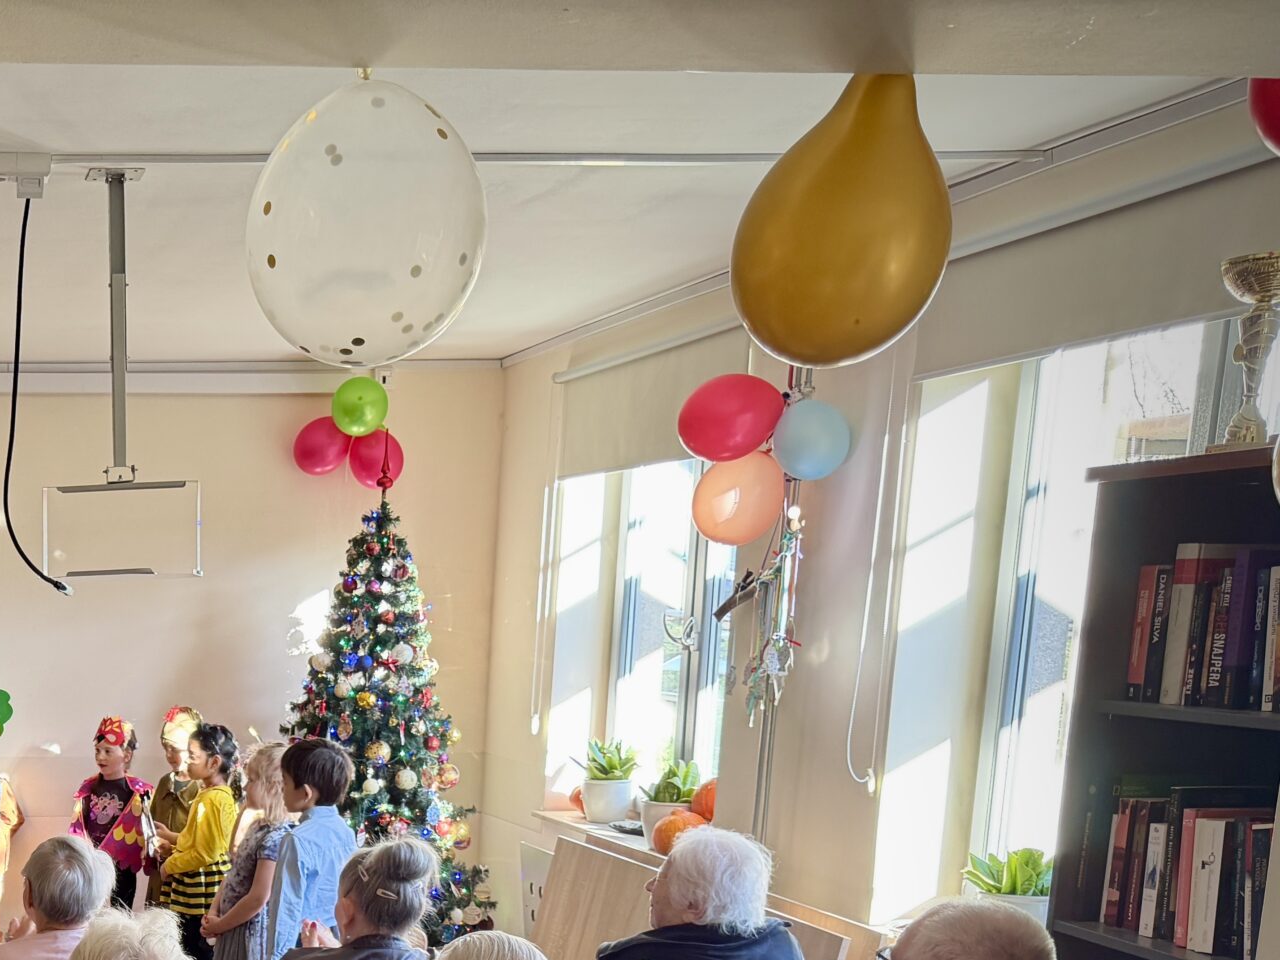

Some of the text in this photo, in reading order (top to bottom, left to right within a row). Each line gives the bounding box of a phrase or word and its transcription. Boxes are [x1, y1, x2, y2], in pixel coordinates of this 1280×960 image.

[1151, 575, 1167, 644] DANIEL SILVA
[1208, 632, 1226, 688] SNAJPERA
